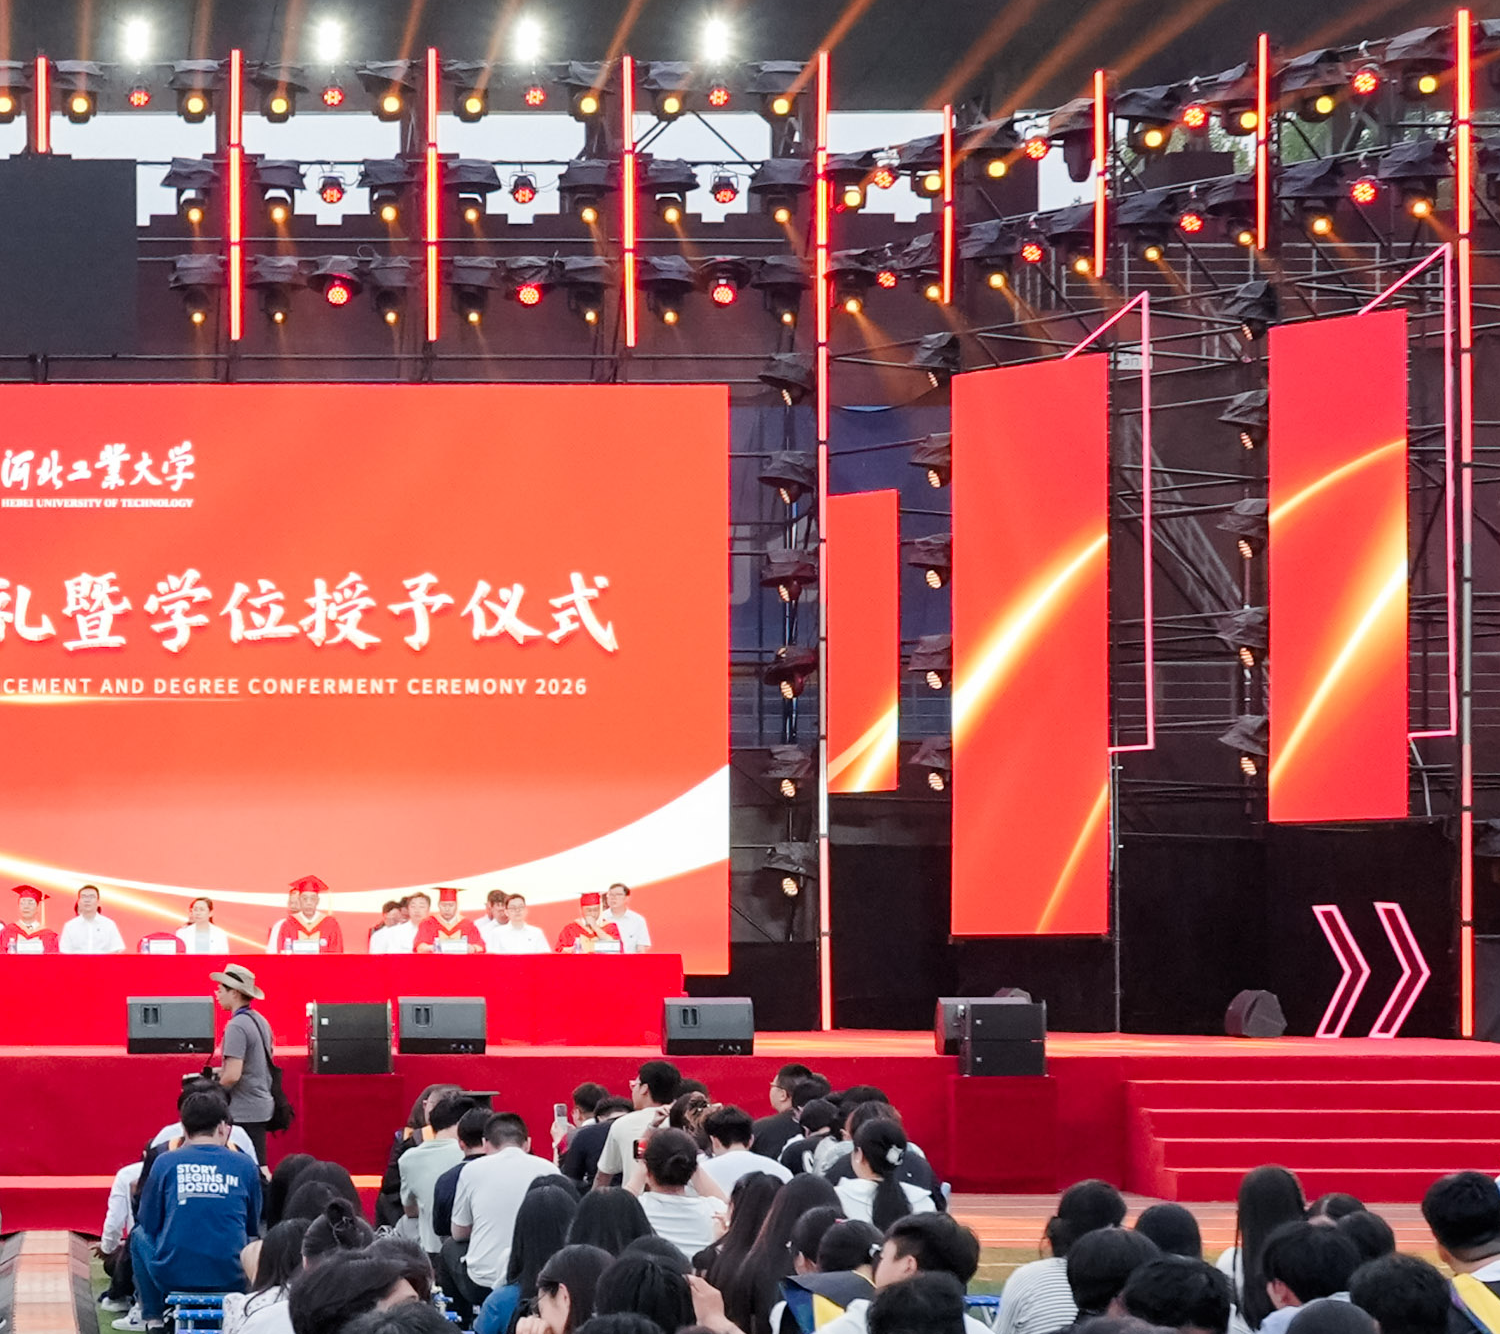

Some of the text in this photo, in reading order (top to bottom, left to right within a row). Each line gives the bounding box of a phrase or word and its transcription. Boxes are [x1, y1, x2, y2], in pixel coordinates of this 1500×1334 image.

[1, 498, 194, 508] HEBEI UNIVERSITY OF TECHNOLOGY
[100, 678, 145, 695] AND
[154, 678, 239, 695] DEGREE
[248, 678, 398, 695] CONFERMENT
[407, 678, 527, 695] CEREMONY
[535, 678, 587, 695] 2026
[176, 1163, 217, 1174] STORY
[177, 1173, 239, 1187] BEGINS IN
[177, 1182, 230, 1195] BOSTON
